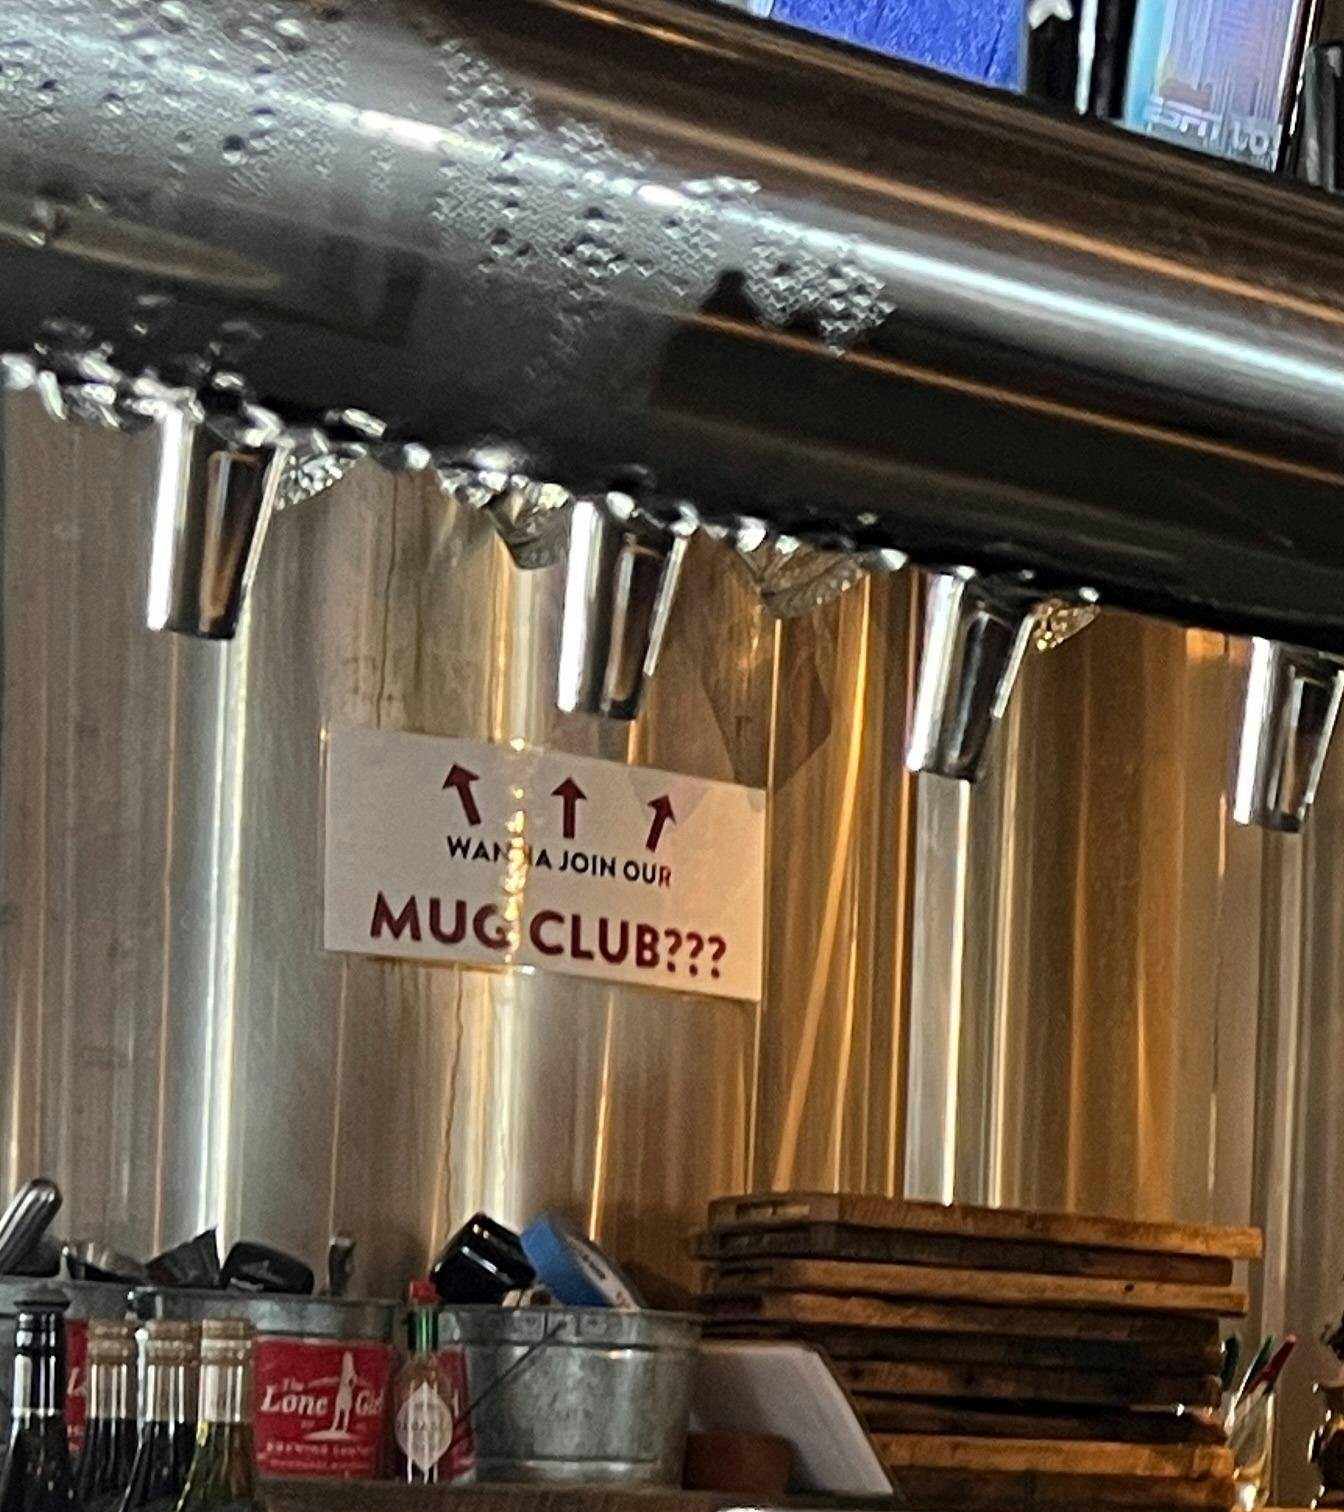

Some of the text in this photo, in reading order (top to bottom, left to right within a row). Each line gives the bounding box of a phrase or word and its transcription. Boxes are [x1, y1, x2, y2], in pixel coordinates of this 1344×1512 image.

[447, 835, 672, 889] WANA JOIN OUR
[369, 890, 727, 979] MUG CLUB???
[260, 1384, 329, 1416] Lone
